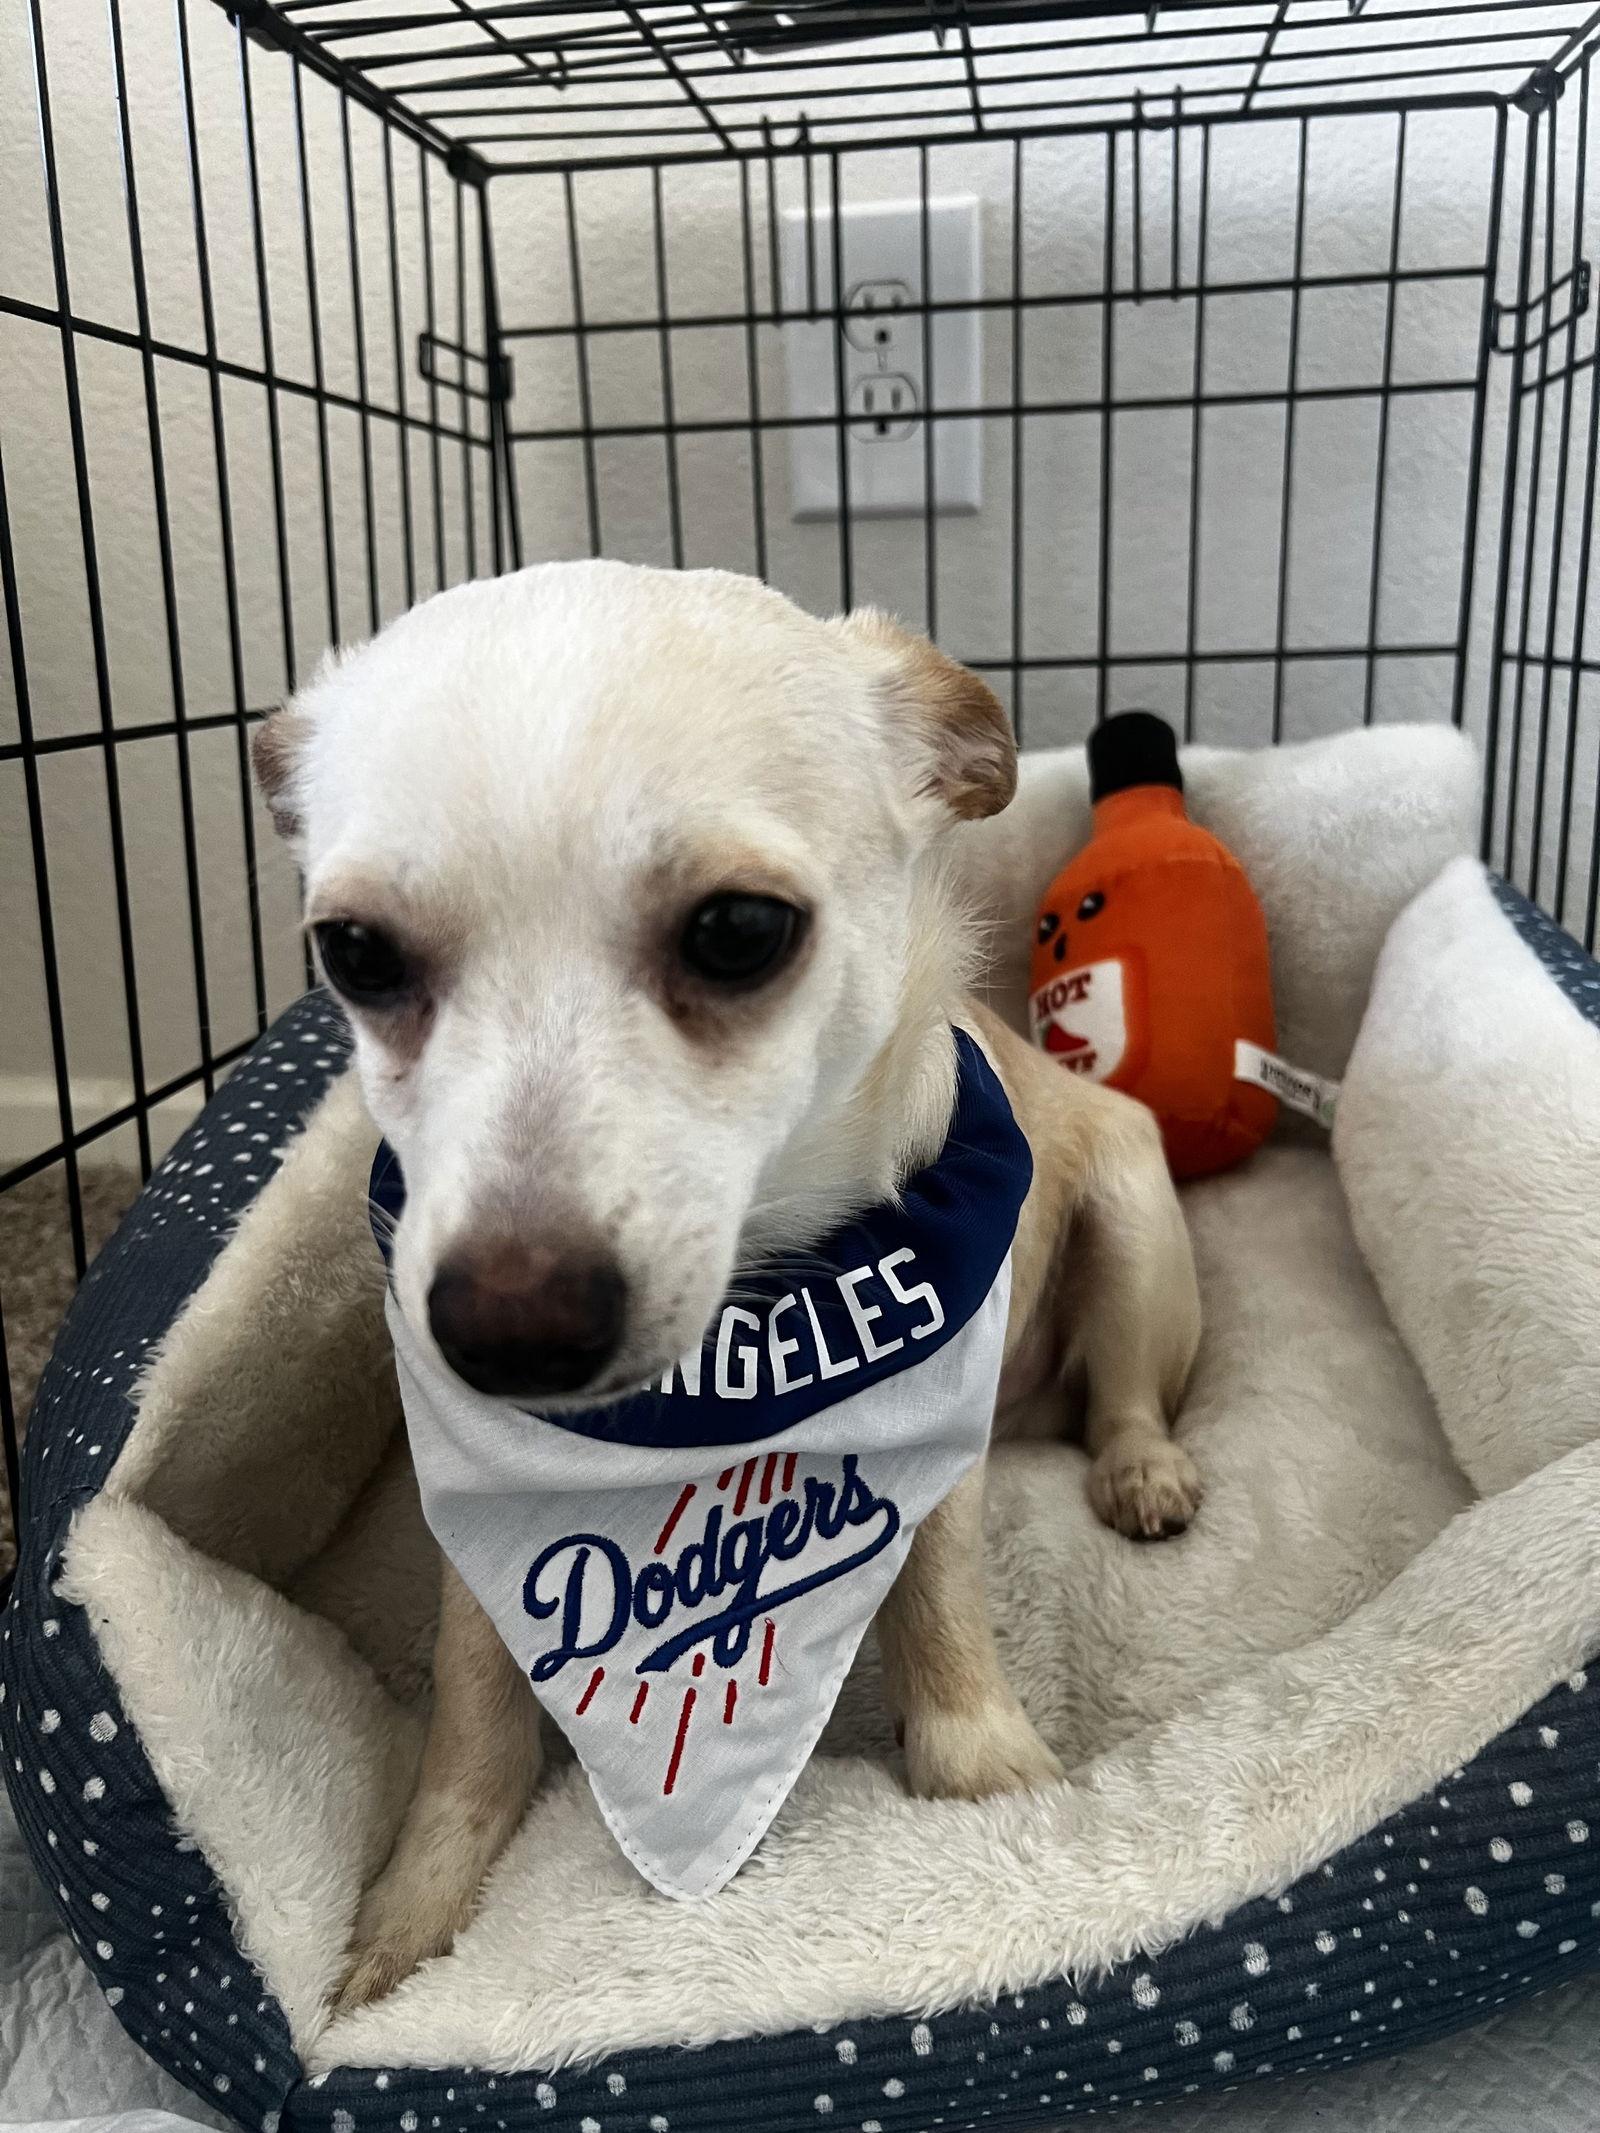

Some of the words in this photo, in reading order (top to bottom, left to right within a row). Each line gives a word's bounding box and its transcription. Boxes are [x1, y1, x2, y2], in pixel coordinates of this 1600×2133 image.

[1037, 971, 1091, 1020] HOT
[642, 1247, 945, 1399] GELES
[522, 1453, 900, 1682] Dodgers
